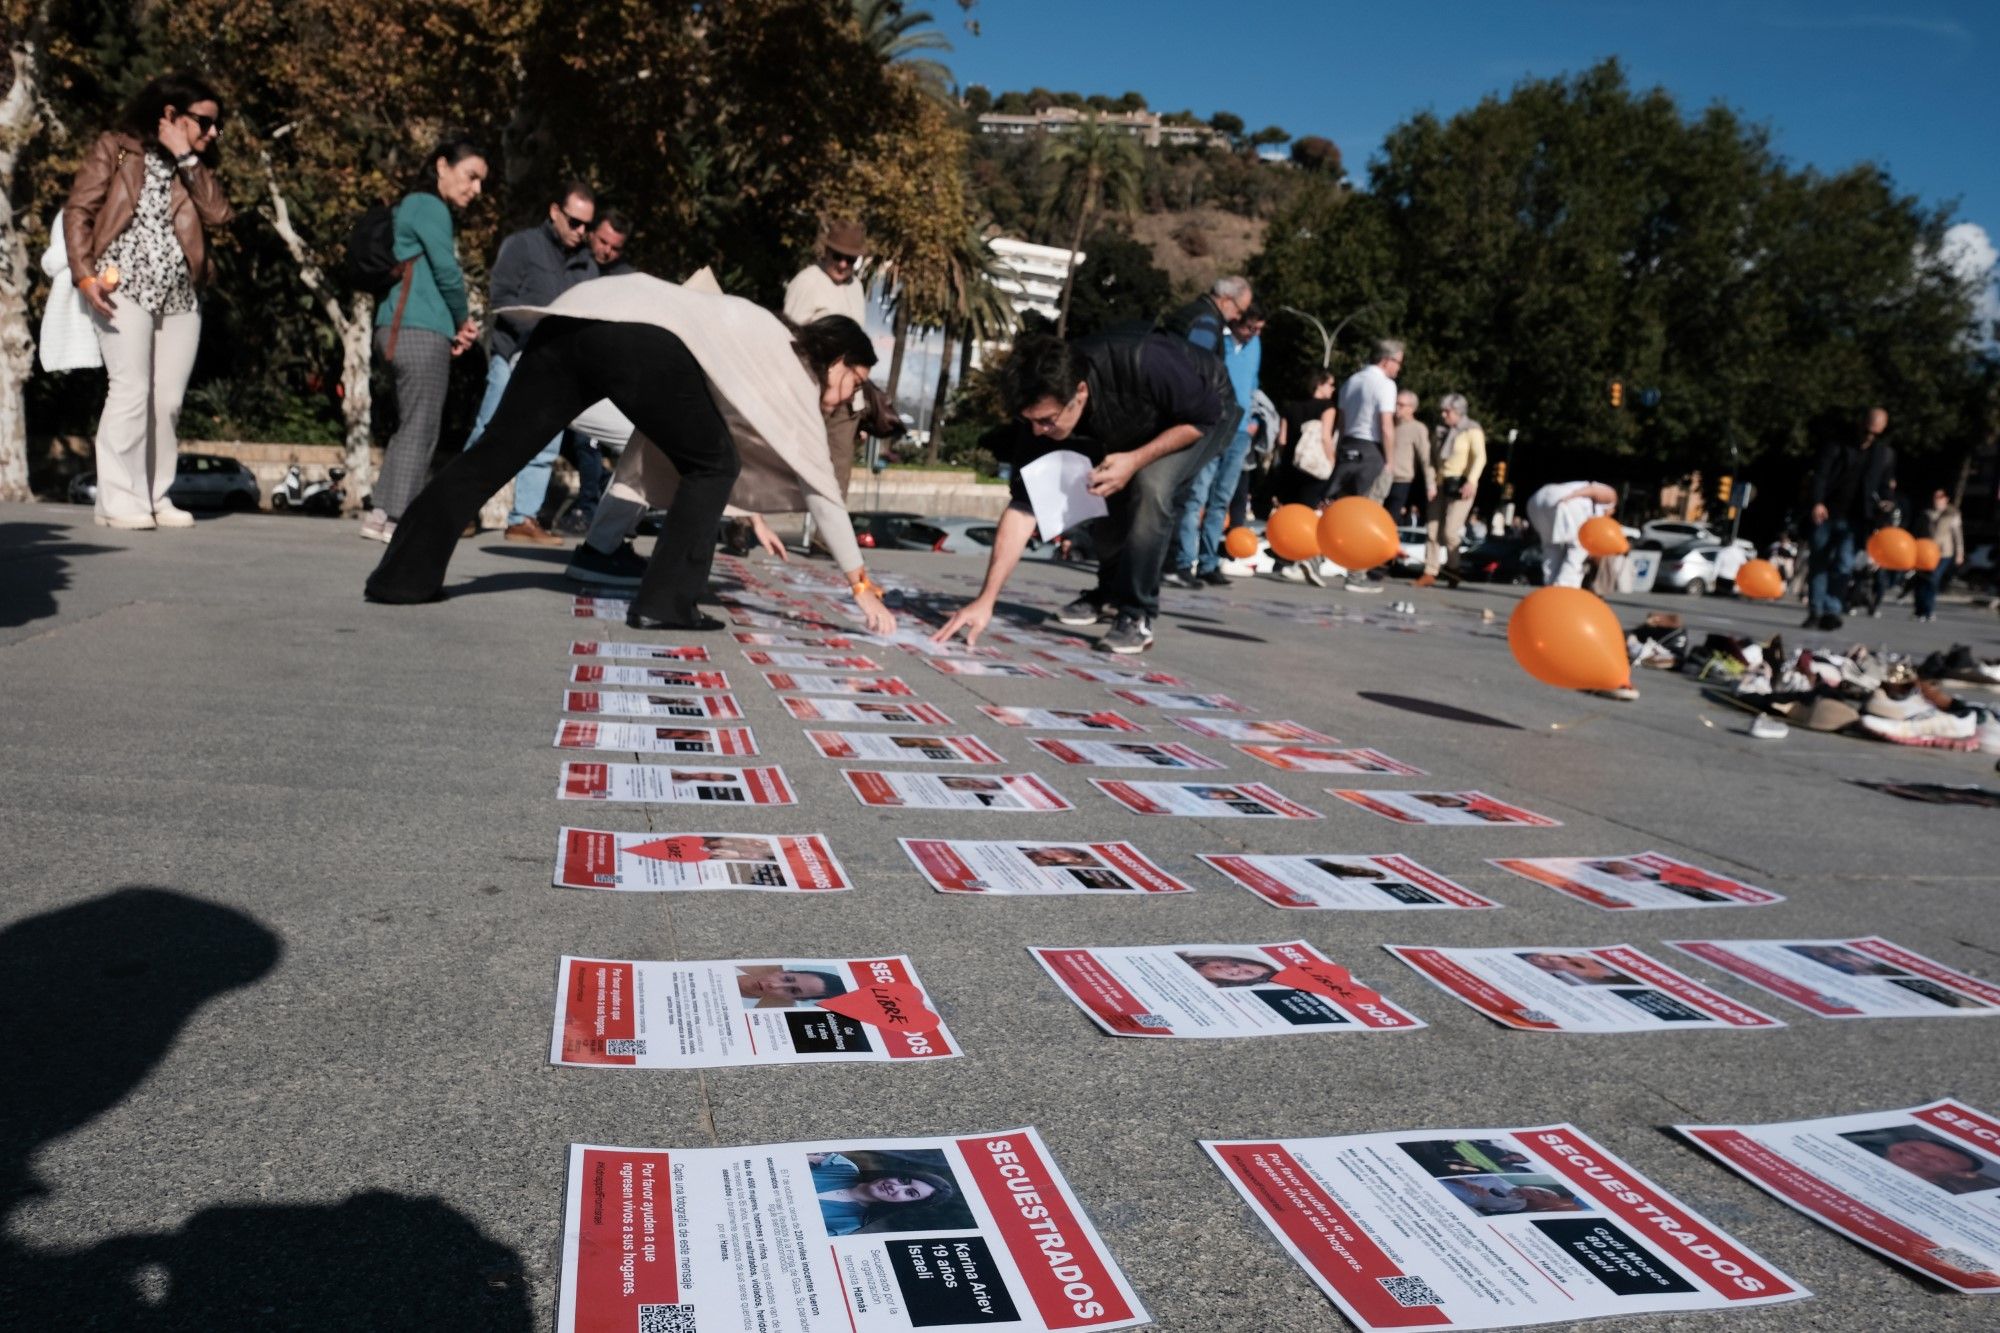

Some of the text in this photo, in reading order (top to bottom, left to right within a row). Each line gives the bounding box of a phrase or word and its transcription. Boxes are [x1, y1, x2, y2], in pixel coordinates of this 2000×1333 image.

[869, 962, 894, 983] SEC
[1357, 1003, 1398, 1025] DOS
[818, 1028, 828, 1040] años
[619, 1162, 632, 1198] regresen
[642, 1163, 654, 1177] Por
[722, 1169, 732, 1196] asesinados
[766, 1157, 778, 1189] secuestrados
[642, 1178, 655, 1200] favor
[1267, 1153, 1284, 1166] Por
[1280, 1167, 1303, 1186] favor
[1299, 1188, 1331, 1216] ayuden
[1334, 1225, 1354, 1241] que
[622, 1200, 636, 1223] vivos
[640, 1201, 656, 1234] ayuden
[1252, 1154, 1285, 1186] regresen
[1283, 1187, 1306, 1208] vivos
[1309, 1216, 1328, 1232] sus
[1324, 1234, 1362, 1272] hogares.
[1293, 1152, 1312, 1168] Capte
[1309, 1169, 1323, 1180] una
[1321, 1181, 1351, 1209] fotografía
[1358, 1219, 1375, 1233] este
[1373, 1235, 1404, 1263] mensaje
[1539, 1134, 1763, 1290] SECUESTRADOS
[672, 1163, 694, 1289] Capte una fotografía de este mensaje
[753, 1213, 763, 1237] hombres
[988, 1141, 1102, 1317] SECUESTRADOS
[622, 1233, 633, 1250] sus
[641, 1244, 655, 1262] que
[735, 1262, 744, 1270] de
[786, 1249, 796, 1267] Franja
[908, 1245, 933, 1278] Israeli
[931, 1244, 957, 1288] 19 años
[1573, 1241, 1617, 1272] Israeli
[1585, 1236, 1640, 1276] 80 años
[1593, 1227, 1669, 1285] Gadi Moses
[620, 1253, 636, 1296] hogares.
[736, 1272, 745, 1282] sus
[745, 1240, 757, 1277] maltratados,
[752, 1278, 762, 1308] violados,
[760, 1262, 771, 1280] cuyas
[789, 1268, 798, 1276] de
[796, 1241, 807, 1260] civiles
[802, 1261, 814, 1292] inocentes
[809, 1293, 819, 1316] fueron
[844, 1254, 866, 1313] terrorista Hamás
[860, 1259, 881, 1304] organización
[870, 1249, 890, 1292] Secuestrado
[882, 1293, 895, 1305] por
[953, 1243, 993, 1313] Karina Ariev
[1506, 1266, 1529, 1285] fueron
[738, 1283, 747, 1301] seres
[765, 1281, 775, 1304] edades
[791, 1277, 801, 1294] Gaza.
[769, 1305, 778, 1318] van
[795, 1296, 805, 1306] Su
[740, 1302, 752, 1330] queridos
[771, 1319, 781, 1328] de
[797, 1307, 810, 1333] parader
